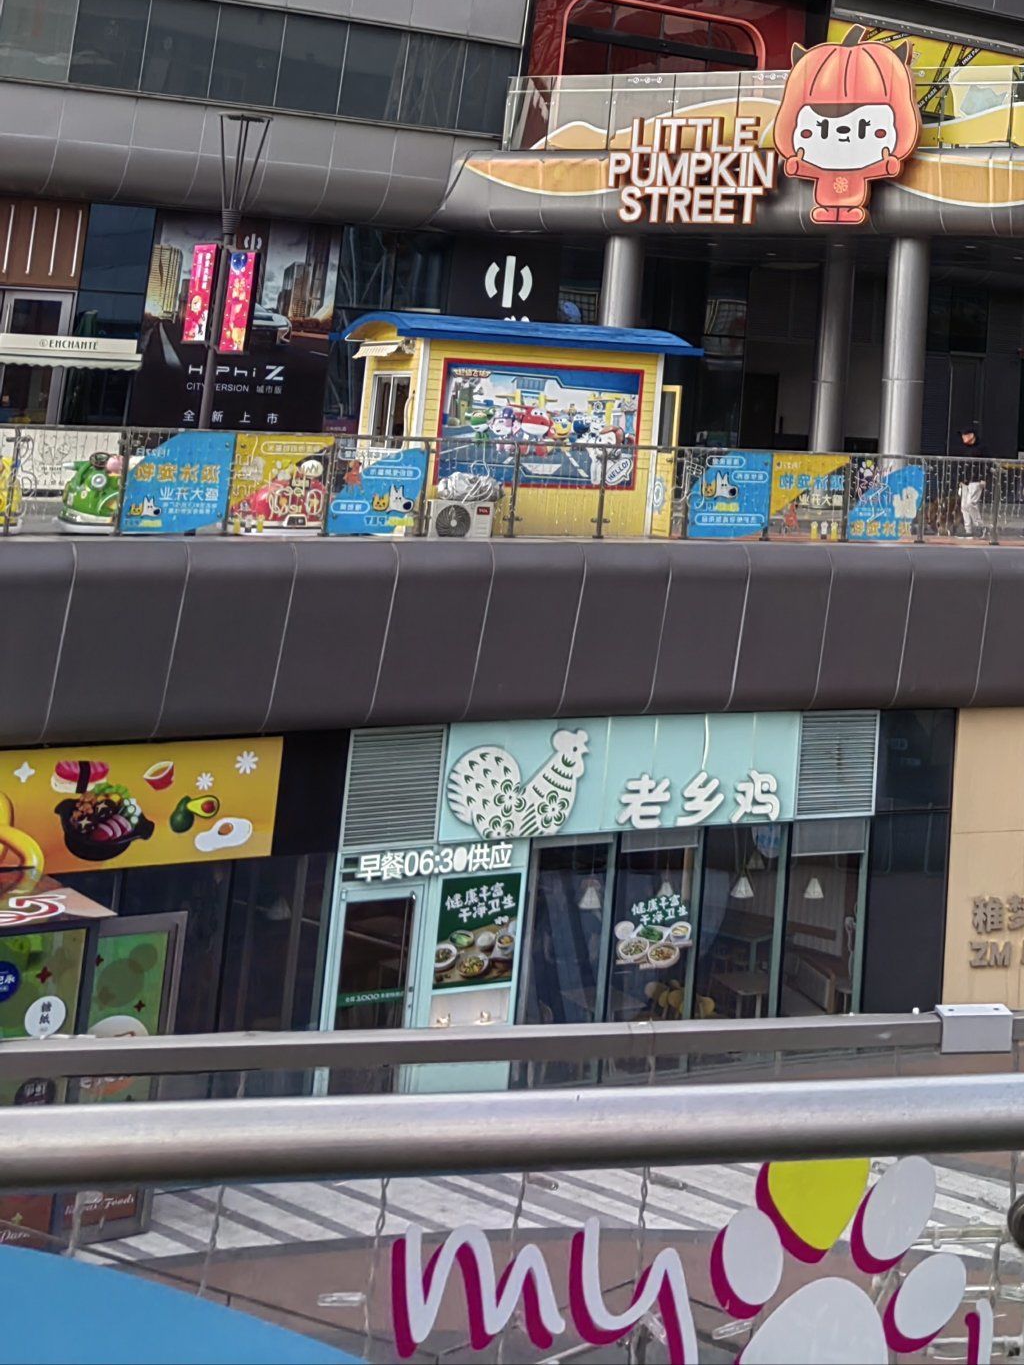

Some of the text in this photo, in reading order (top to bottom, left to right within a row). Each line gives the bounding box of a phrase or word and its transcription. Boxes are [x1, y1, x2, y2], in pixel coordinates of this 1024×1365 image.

[630, 117, 760, 154] LITTLE
[608, 151, 779, 189] PUMPKIN
[619, 186, 764, 224] STREET
[188, 364, 285, 382] HPhi Z
[214, 384, 250, 393] ERSION
[182, 409, 280, 425] 全新上市
[616, 769, 780, 829] 老乡鸡
[357, 842, 513, 882] 早餐06:30供应
[445, 882, 506, 911] 健康丰富
[458, 896, 516, 923] 干净卫生
[631, 894, 682, 917] 健康丰富
[639, 906, 689, 925] 干净卫生
[969, 939, 1012, 969] ZM
[391, 1215, 702, 1365] my
